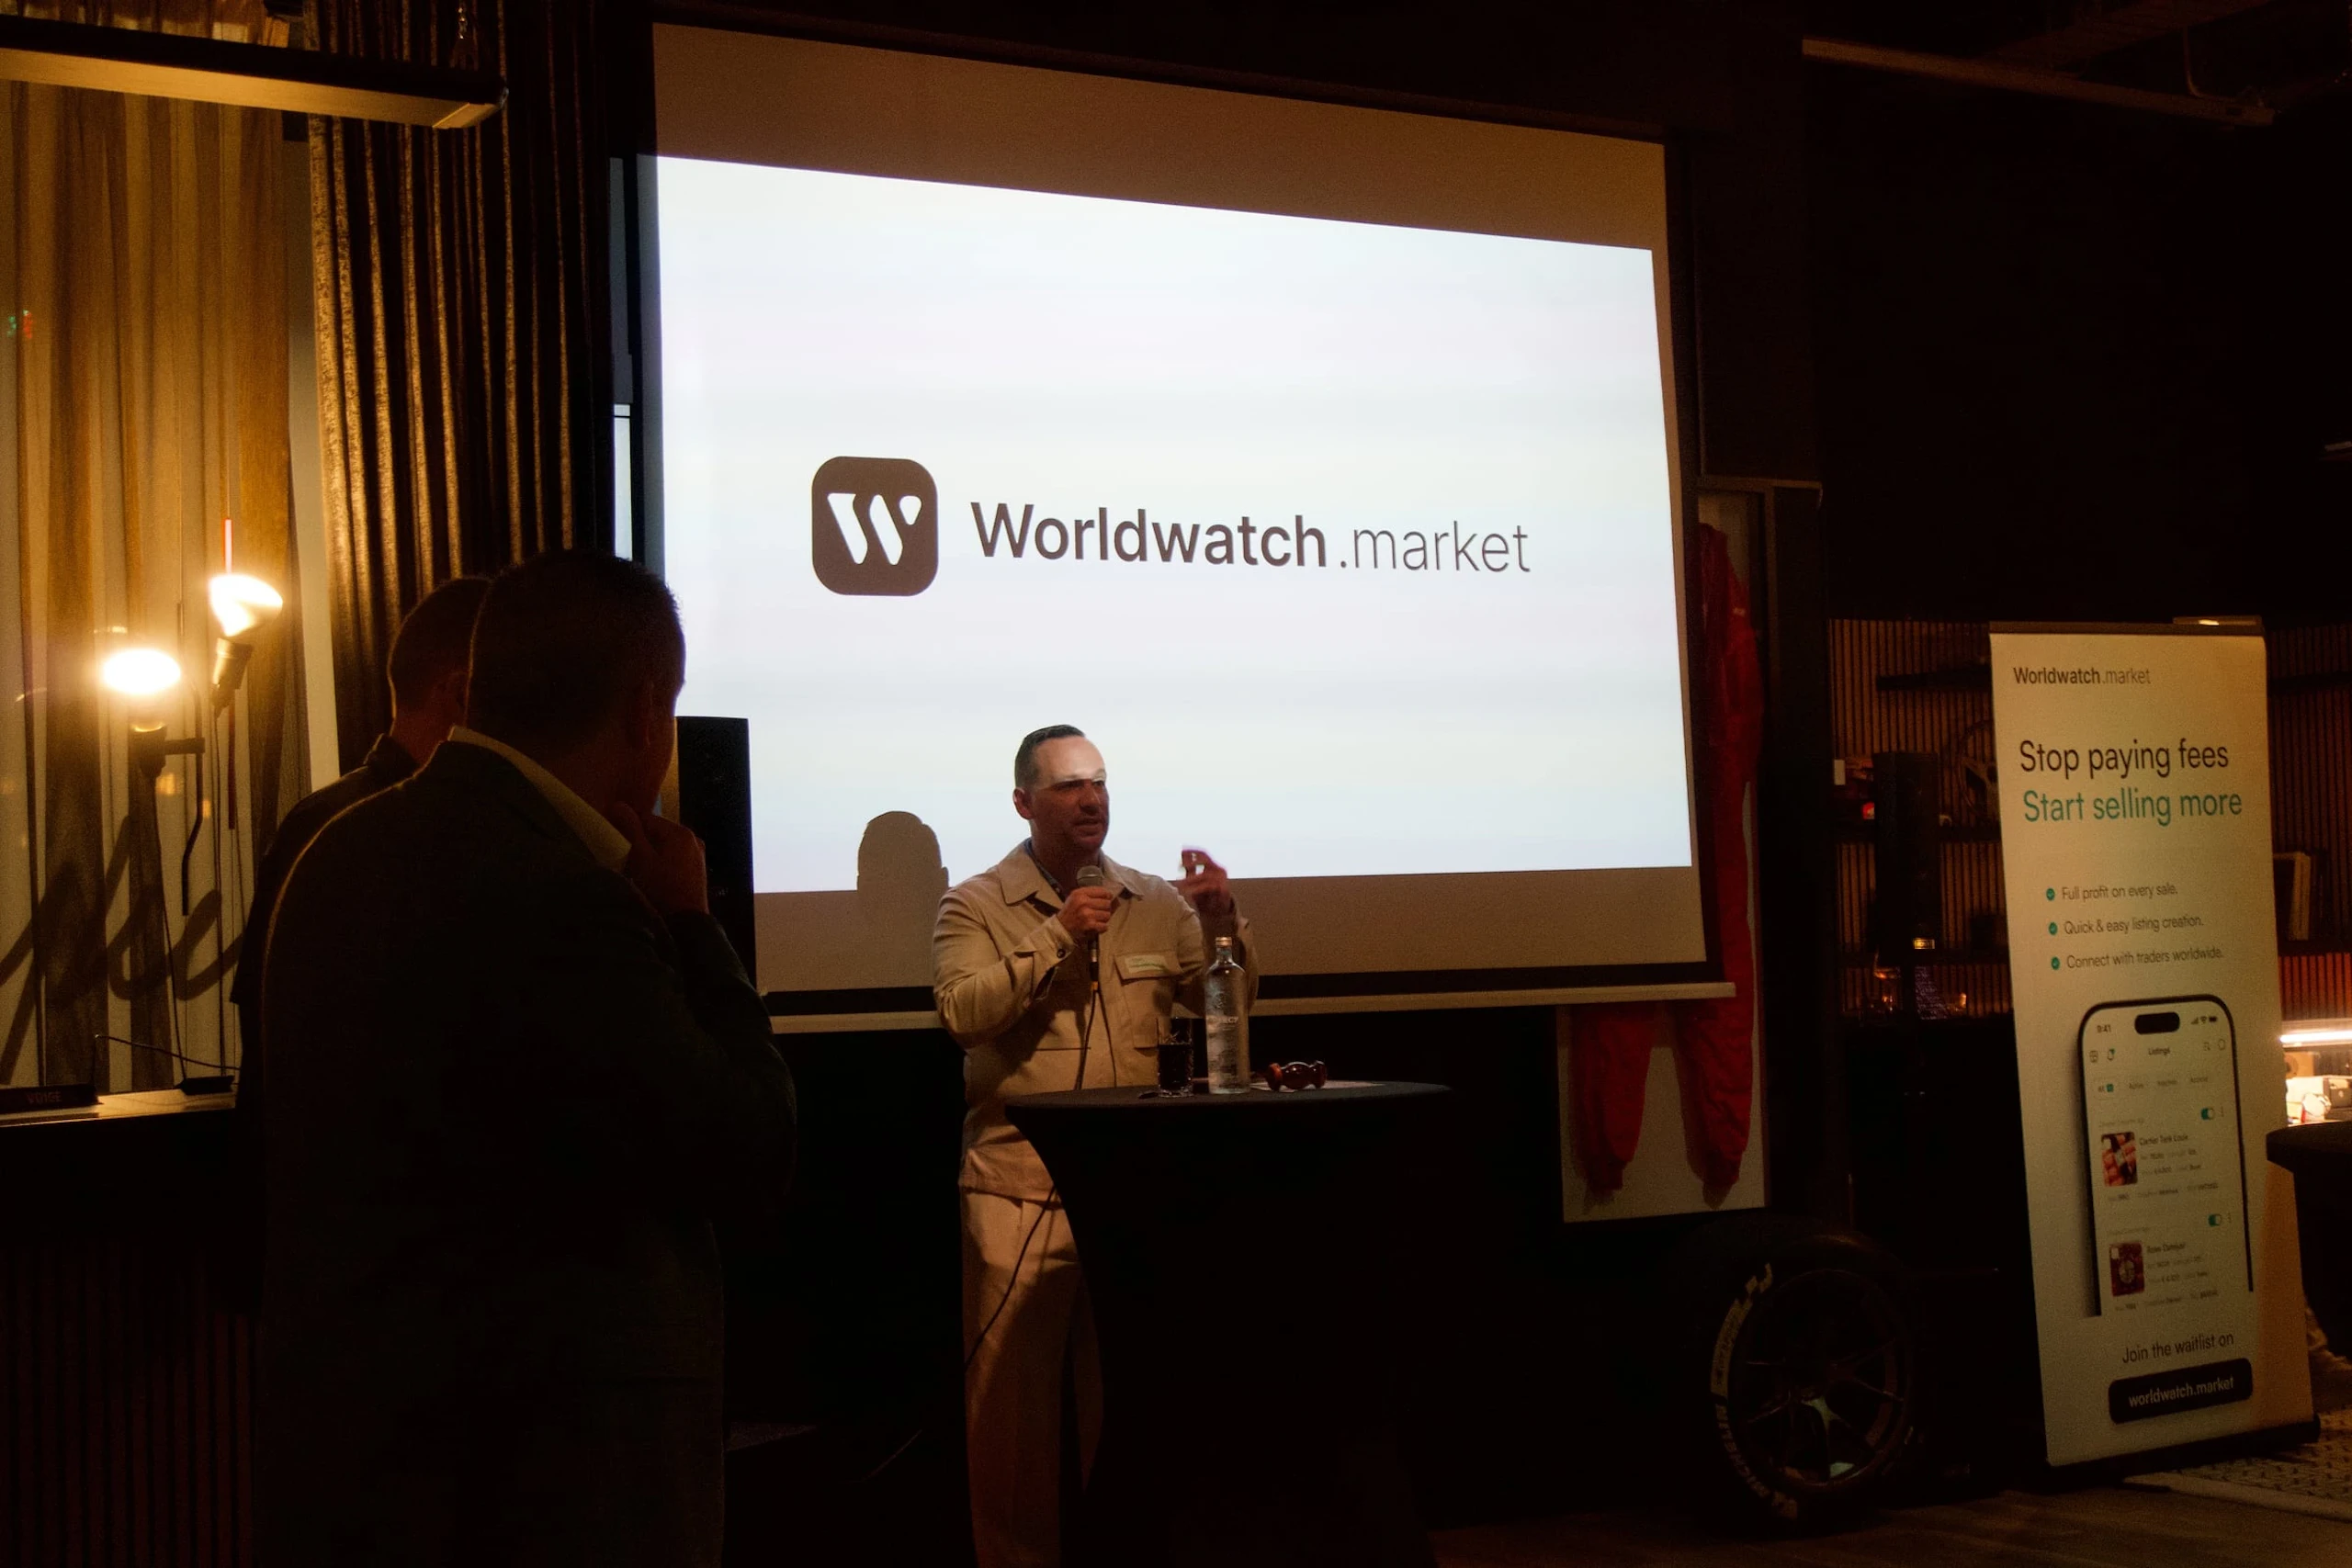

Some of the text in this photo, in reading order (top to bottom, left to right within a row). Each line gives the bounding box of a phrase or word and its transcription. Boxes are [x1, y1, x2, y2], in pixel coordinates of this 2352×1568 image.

[970, 501, 1531, 574] Worldwatch.market
[2013, 667, 2151, 684] Worldwatch.market
[2019, 739, 2229, 779] Stop paying fees
[2023, 787, 2243, 827] Start selling more
[2062, 882, 2178, 903] Full profit on every sale.
[2064, 916, 2204, 935] Quick & easy listing creation.
[2066, 946, 2223, 969] Connect with traders worldwide.
[2122, 1334, 2233, 1363] Join the waitlist on
[2129, 1377, 2234, 1407] worldwatch.market
